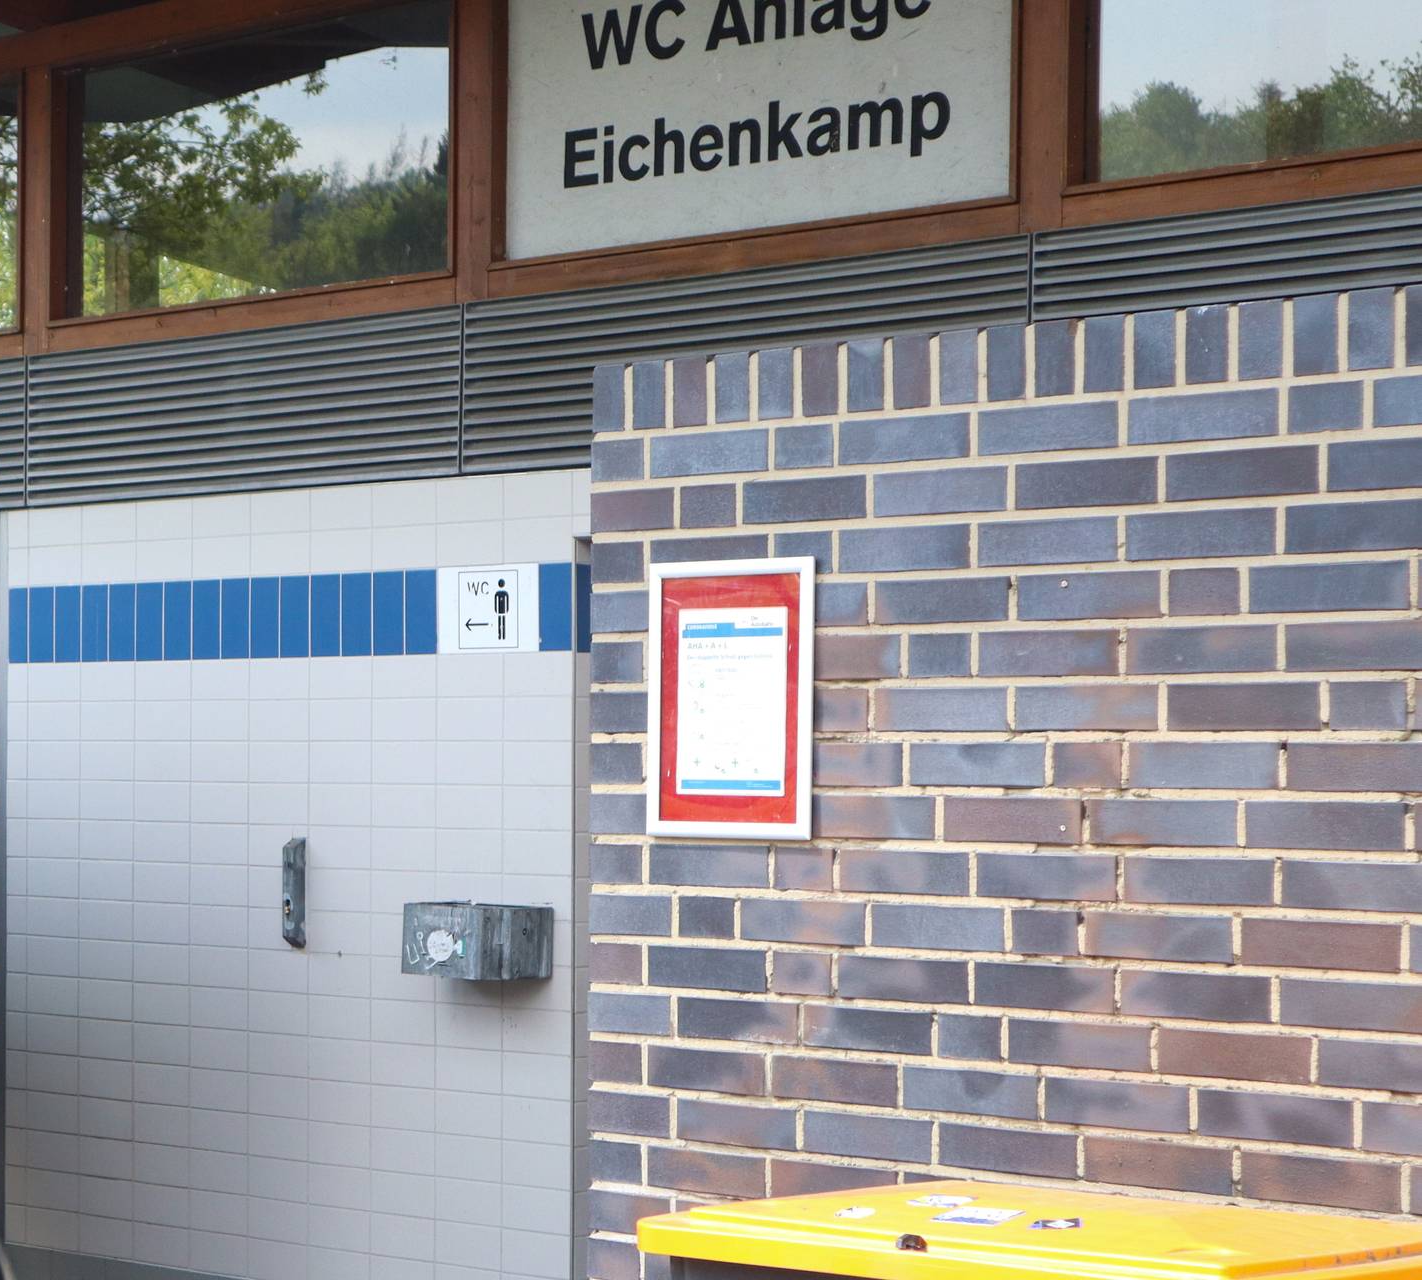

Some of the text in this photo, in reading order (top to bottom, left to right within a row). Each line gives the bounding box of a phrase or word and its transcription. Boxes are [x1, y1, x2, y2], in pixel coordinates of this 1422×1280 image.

[581, 0, 686, 70] WC
[563, 91, 951, 188] Eichenkamp
[467, 581, 489, 597] WC
